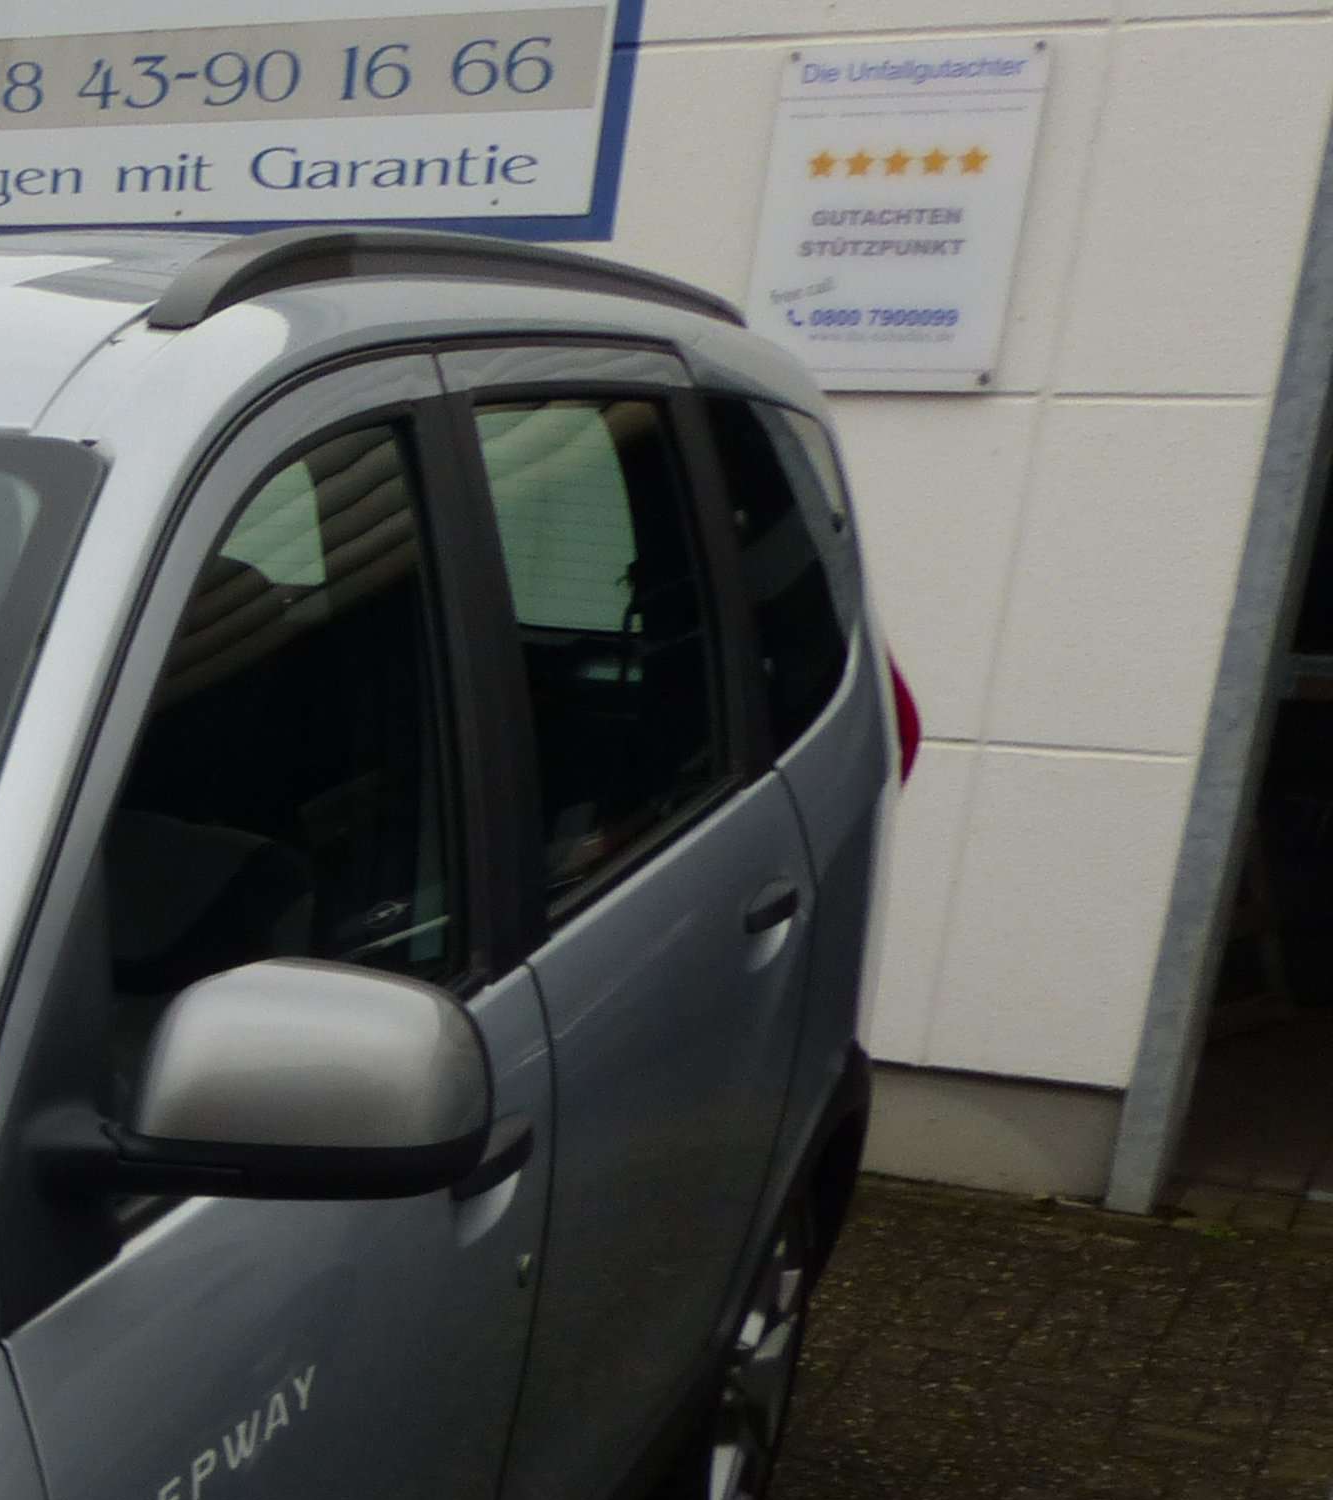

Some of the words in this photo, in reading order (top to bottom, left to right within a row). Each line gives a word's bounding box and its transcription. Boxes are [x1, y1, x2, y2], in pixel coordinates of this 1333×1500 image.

[77, 49, 302, 110] 43-90
[340, 43, 413, 101] 16
[451, 35, 554, 97] 66
[801, 62, 840, 85] Die
[847, 56, 1030, 85] Unfallgutachter
[115, 153, 213, 194] mit
[250, 144, 539, 191] Garantie
[811, 207, 966, 226] GUTACHTEN
[798, 237, 968, 258] STÜTZPUNKT
[809, 308, 862, 327] 0800
